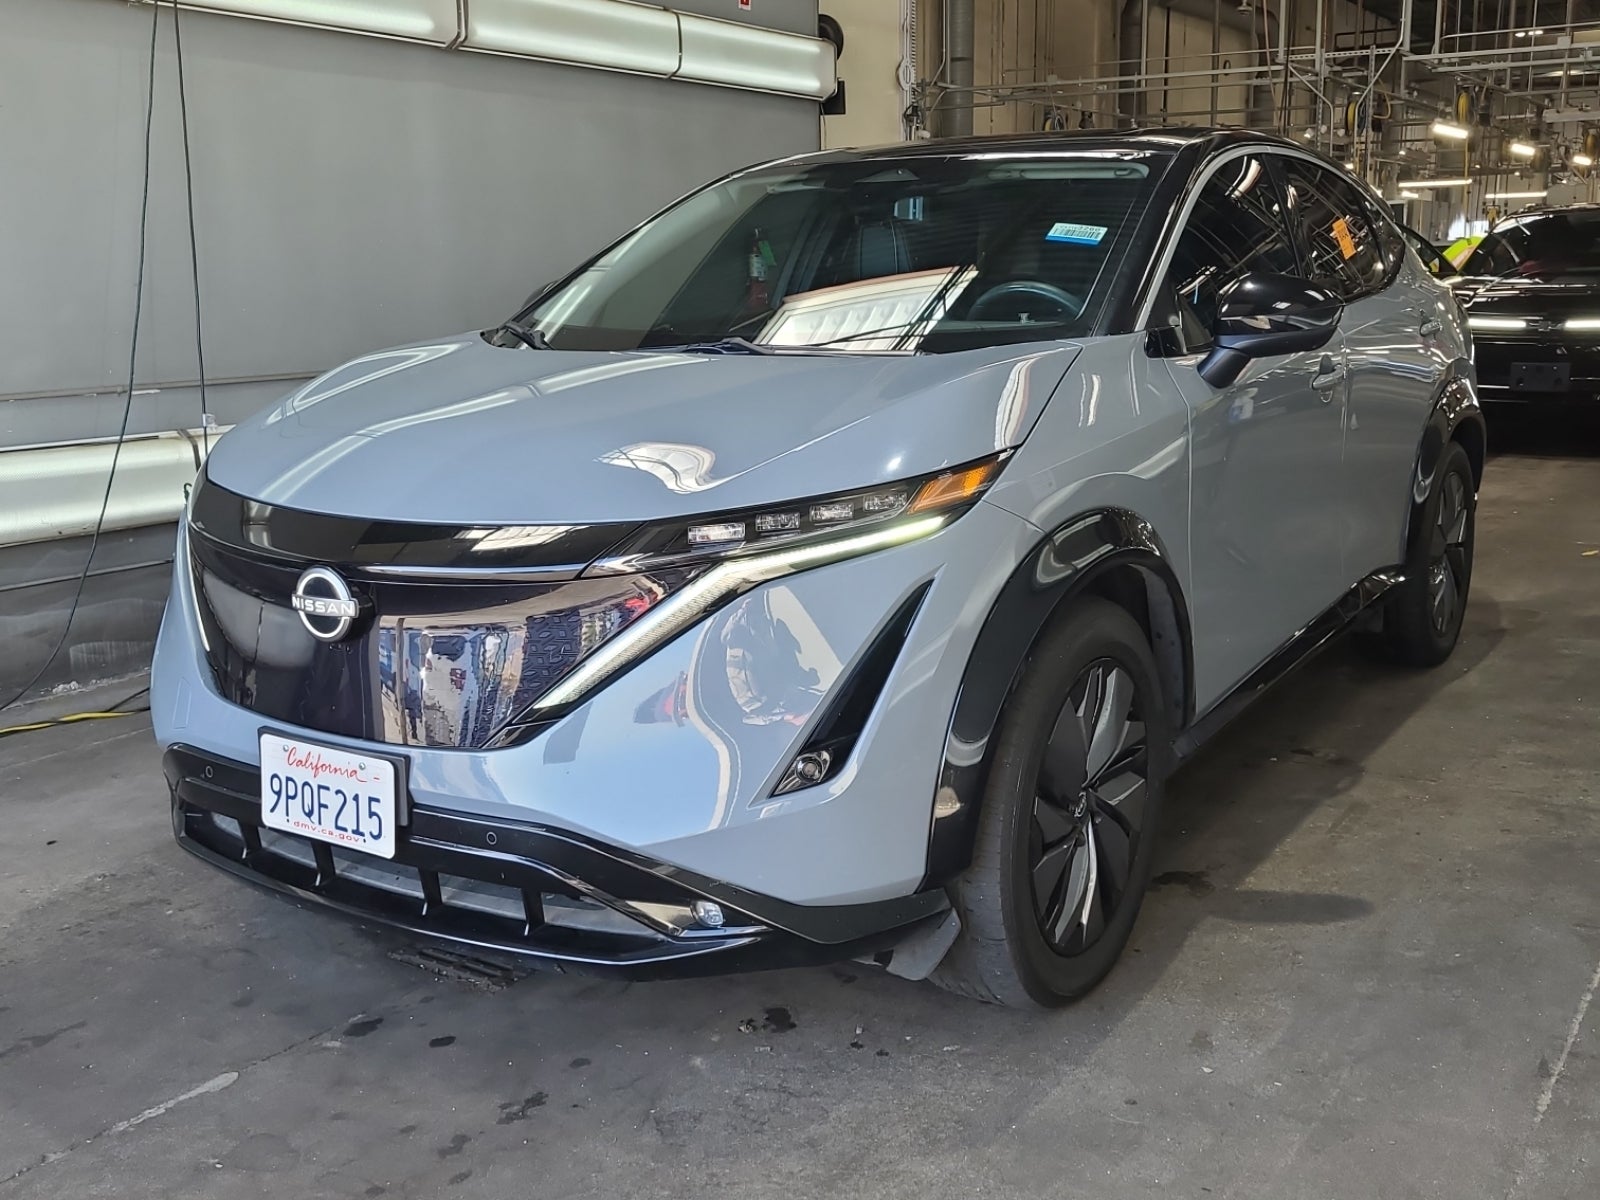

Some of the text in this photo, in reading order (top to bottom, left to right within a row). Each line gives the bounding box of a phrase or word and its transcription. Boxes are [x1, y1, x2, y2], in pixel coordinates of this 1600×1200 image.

[292, 596, 353, 615] NISSAN
[287, 747, 367, 782] California
[270, 773, 382, 840] 9PQF215
[293, 821, 360, 842] dmv.ca.gov
